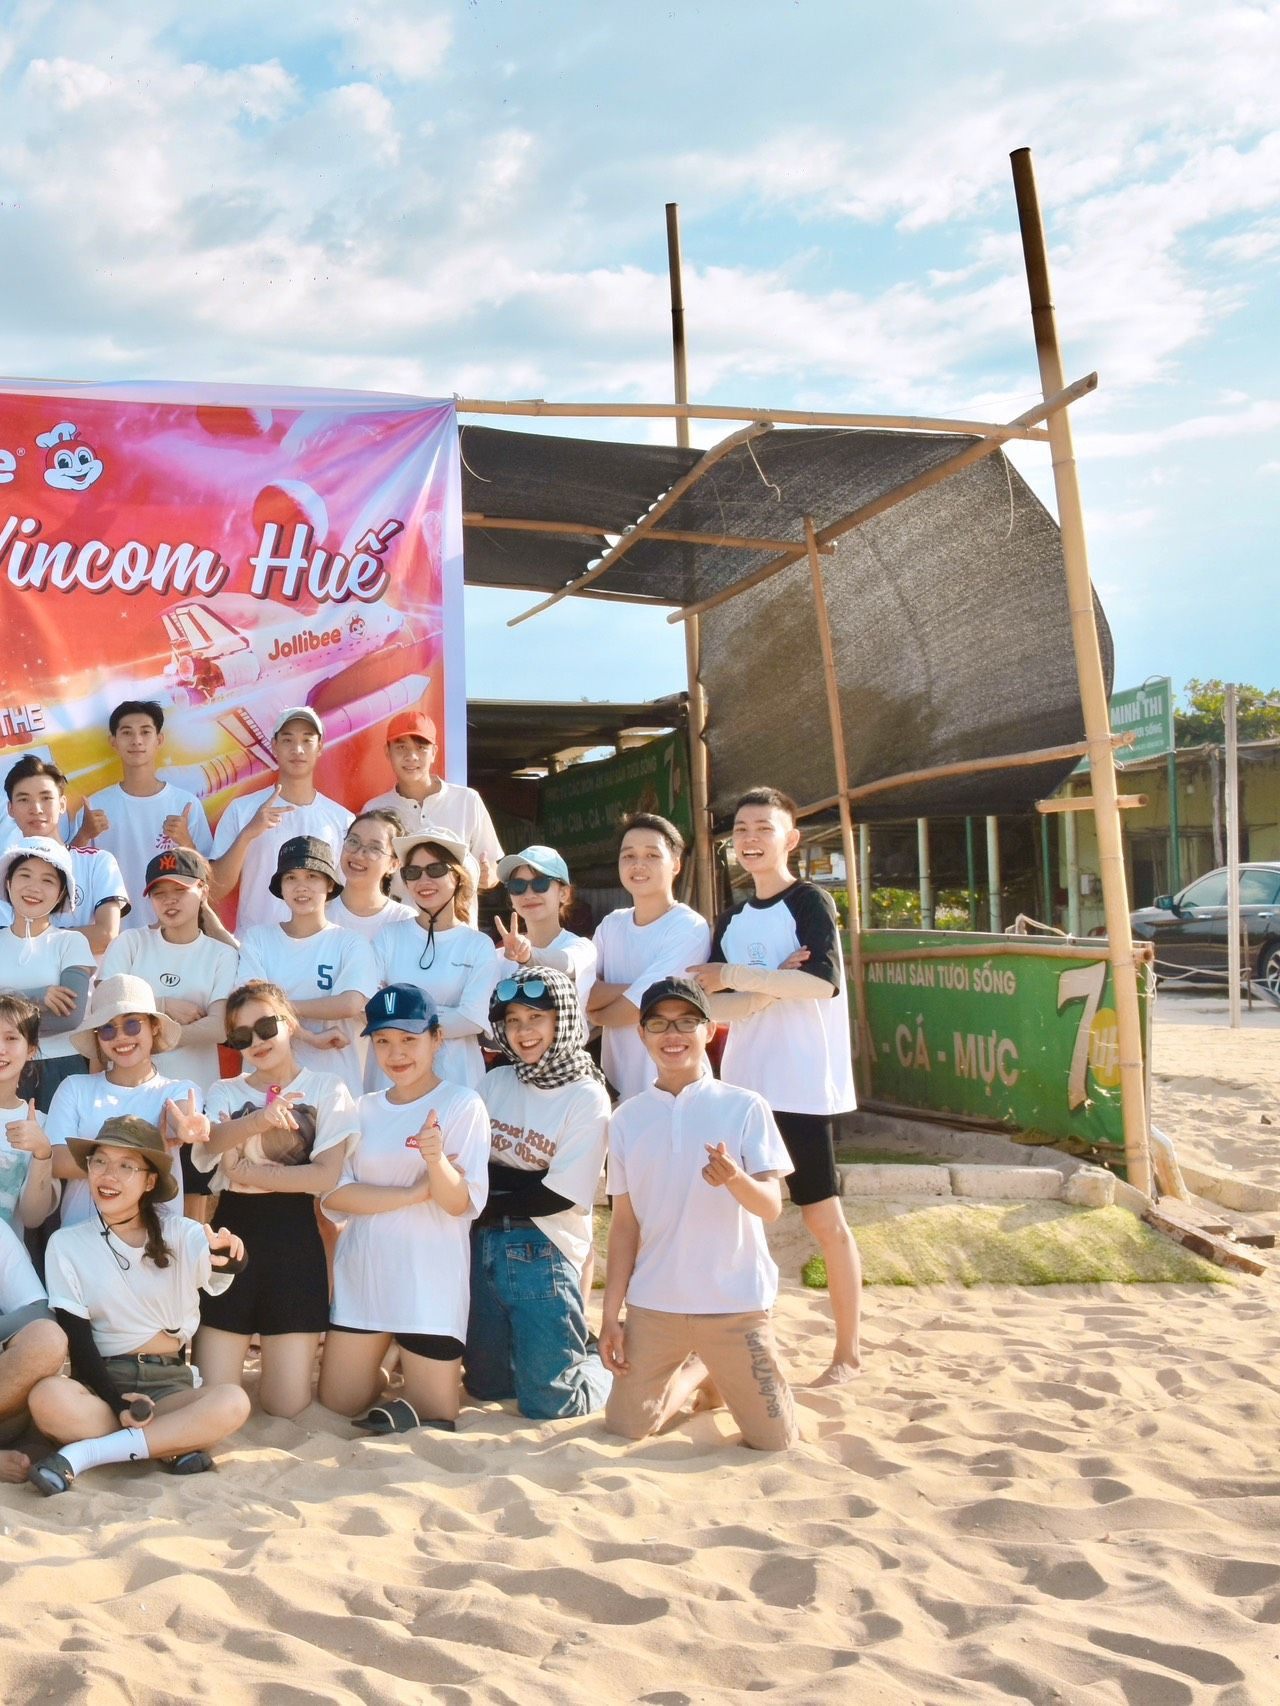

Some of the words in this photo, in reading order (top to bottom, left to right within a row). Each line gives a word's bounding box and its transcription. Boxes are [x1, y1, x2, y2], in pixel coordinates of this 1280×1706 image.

[250, 518, 404, 602] Huế
[268, 628, 341, 661] Jollibee
[973, 959, 1017, 996] SỐNG
[953, 1029, 1019, 1097] MỰC
